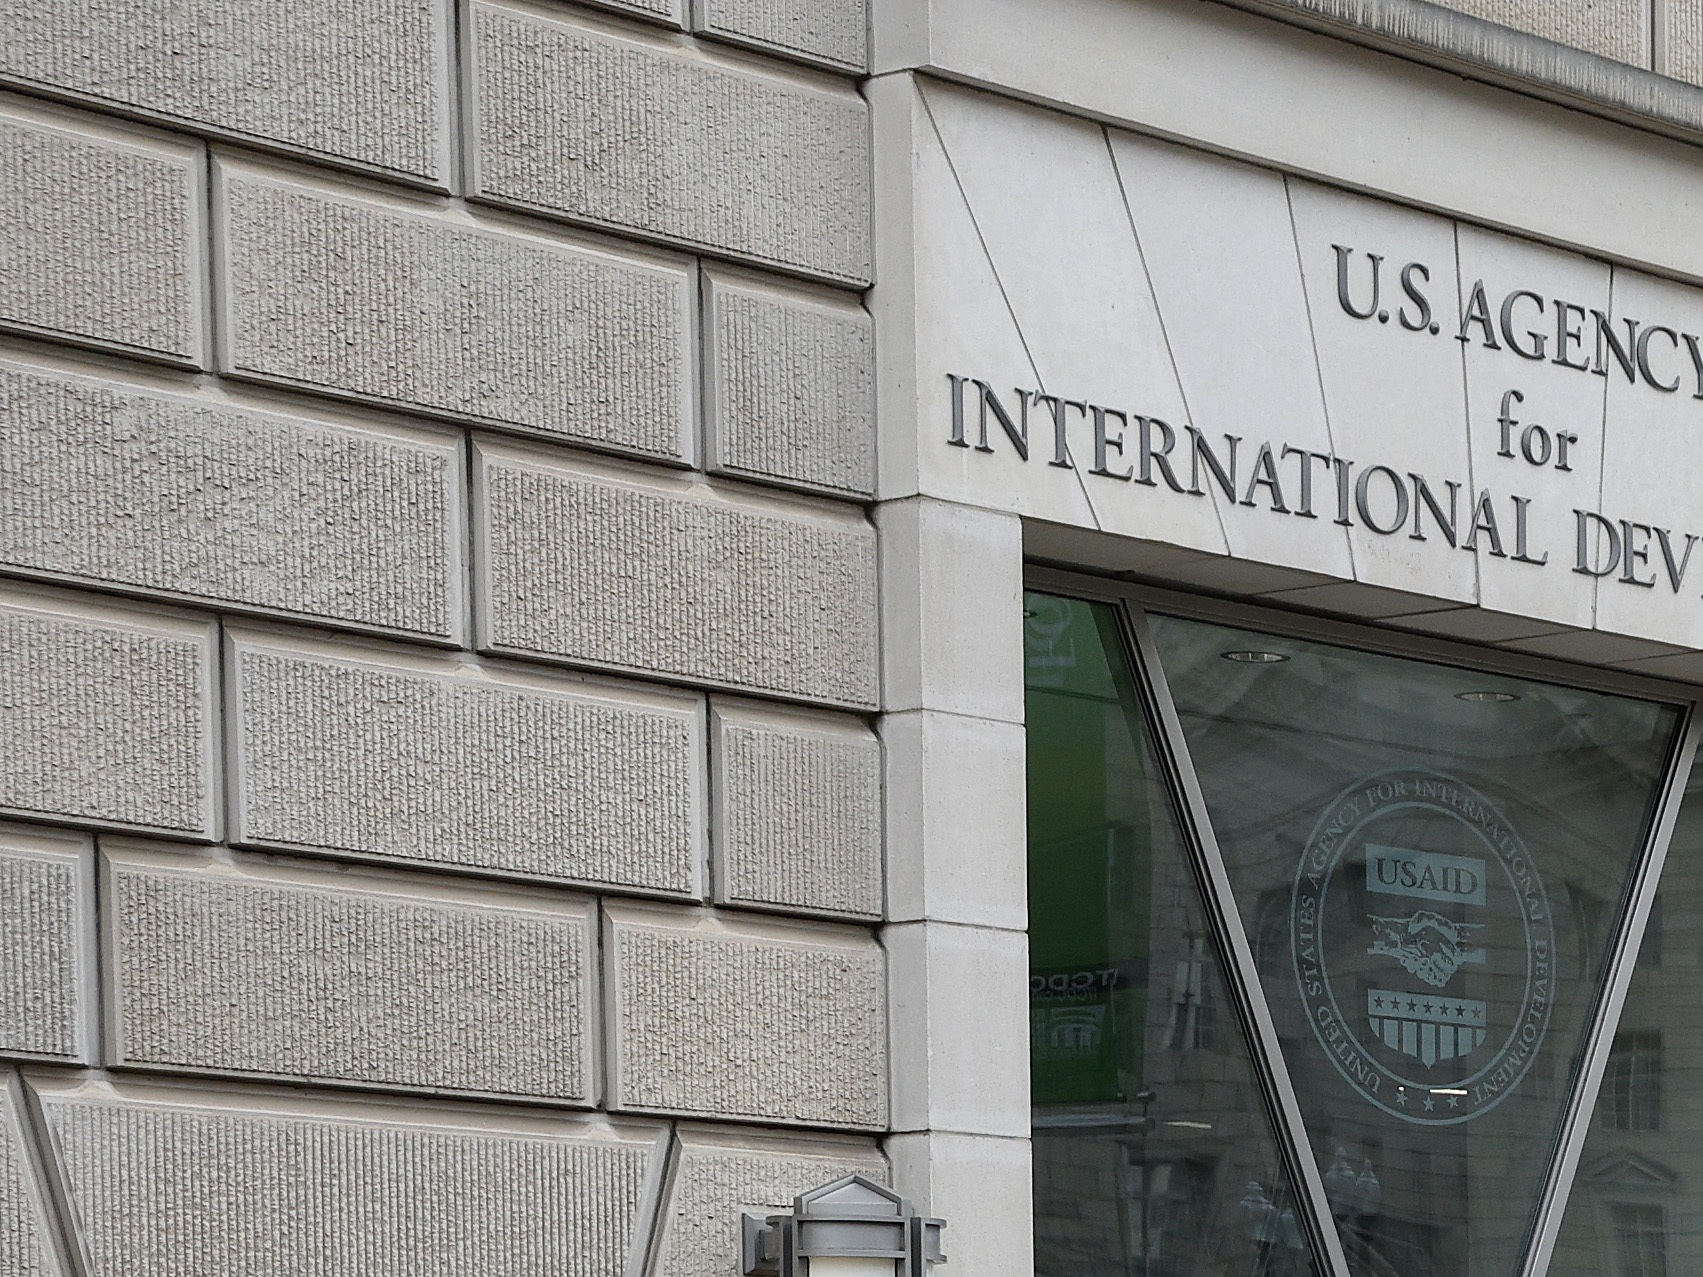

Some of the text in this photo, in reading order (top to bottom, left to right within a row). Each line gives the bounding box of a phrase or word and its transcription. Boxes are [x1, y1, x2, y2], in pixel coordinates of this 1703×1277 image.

[1331, 243, 1441, 336] U.S.
[947, 372, 1549, 566] INTERNATIONAL
[1497, 389, 1577, 472] for
[1376, 857, 1478, 895] USAID
[1306, 779, 1549, 1105] UNITED STATES AGENCY FOR INTERNATIONAL DEVELOPMENT
